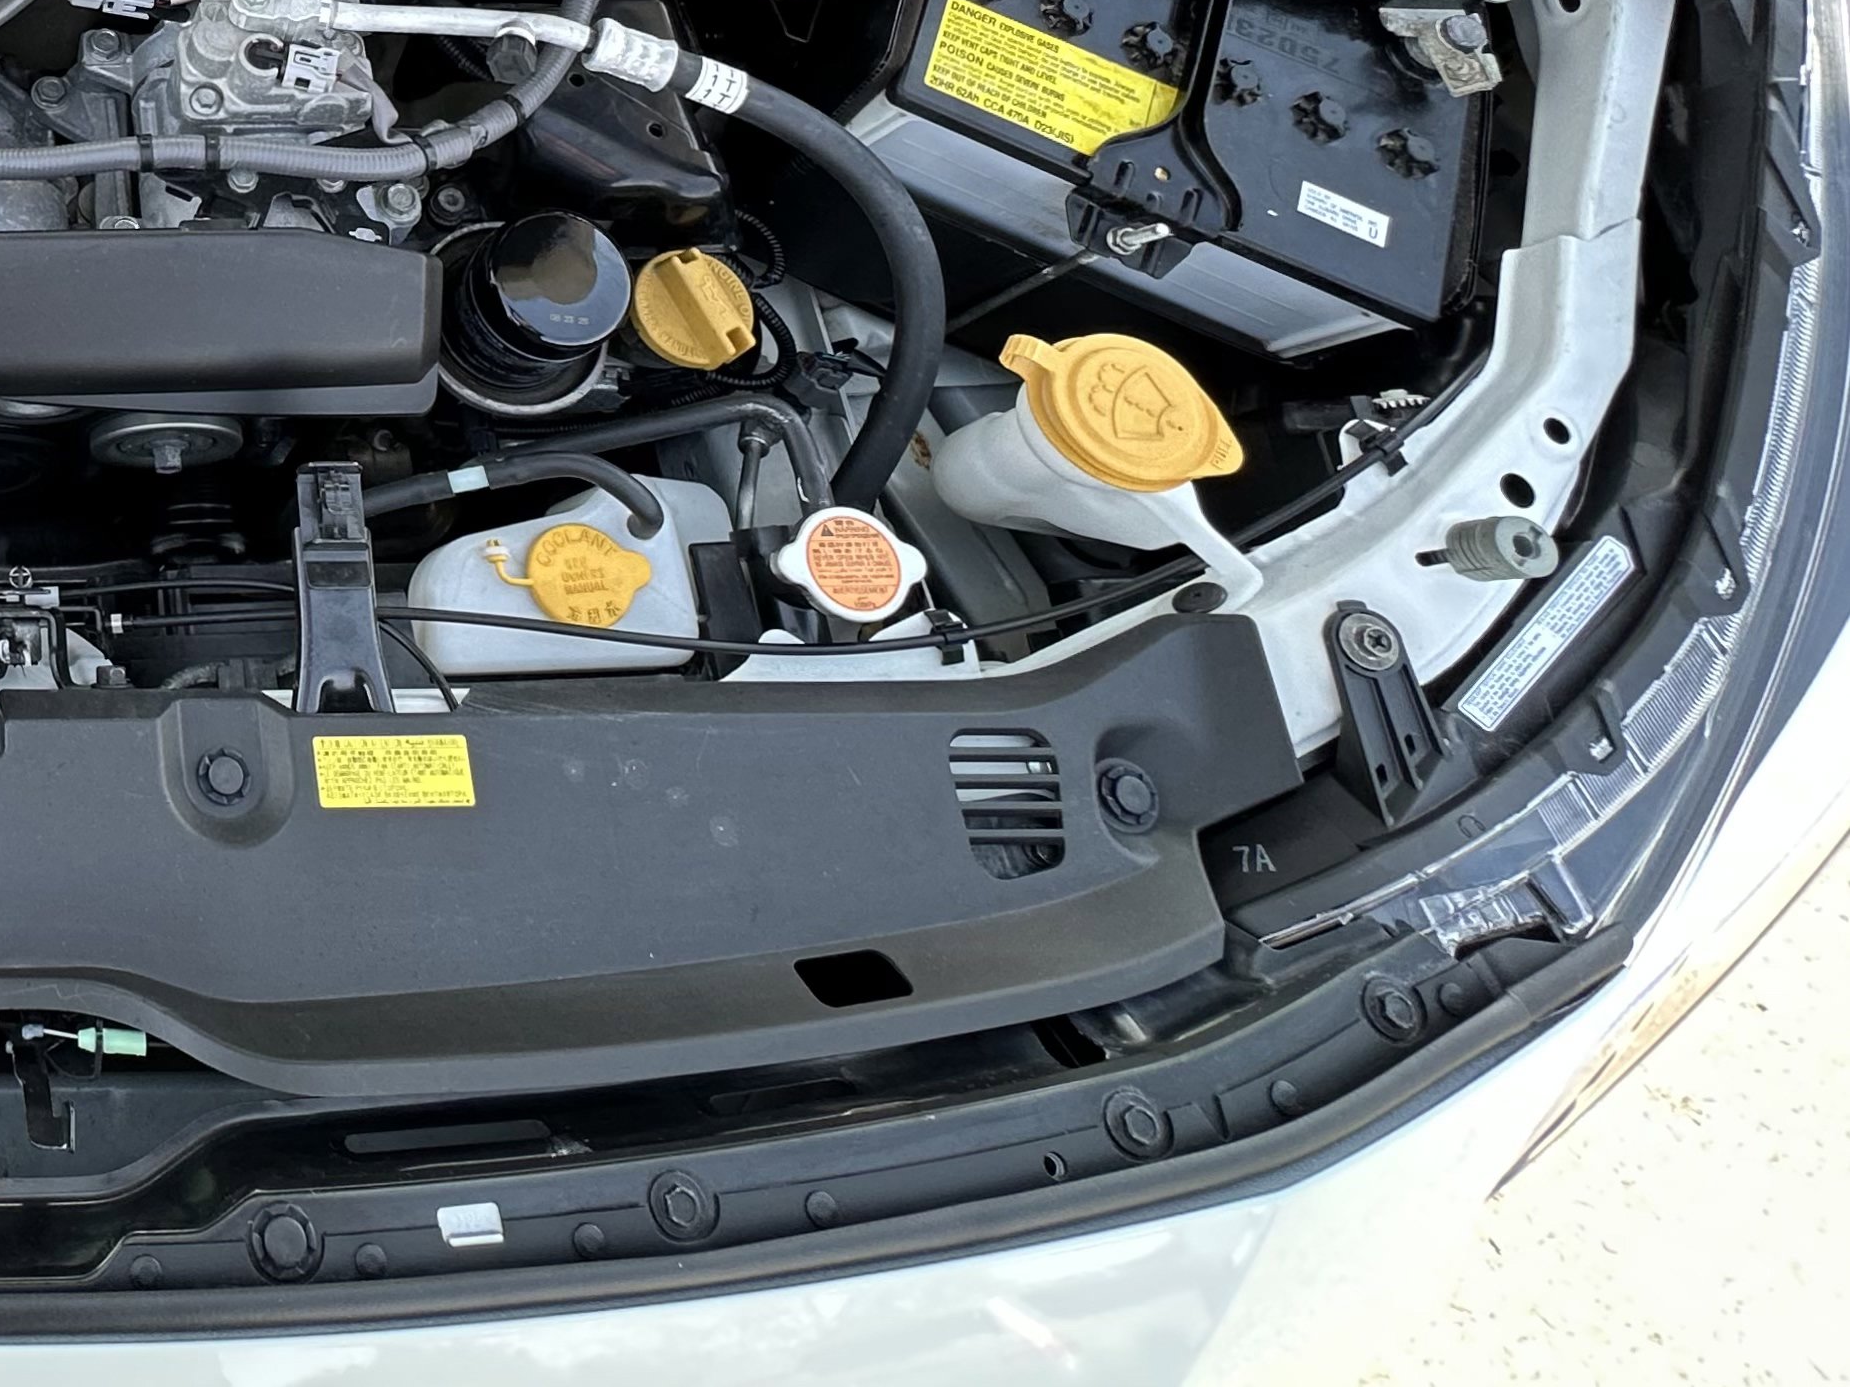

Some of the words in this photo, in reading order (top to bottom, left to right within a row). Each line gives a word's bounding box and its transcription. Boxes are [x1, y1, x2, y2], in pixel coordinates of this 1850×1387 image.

[950, 0, 997, 26] DANGER
[938, 40, 985, 66] POISON
[982, 97, 1006, 113] CCA
[1366, 226, 1379, 239] U
[535, 526, 618, 567] COOLANT
[1232, 844, 1277, 872] 7A
